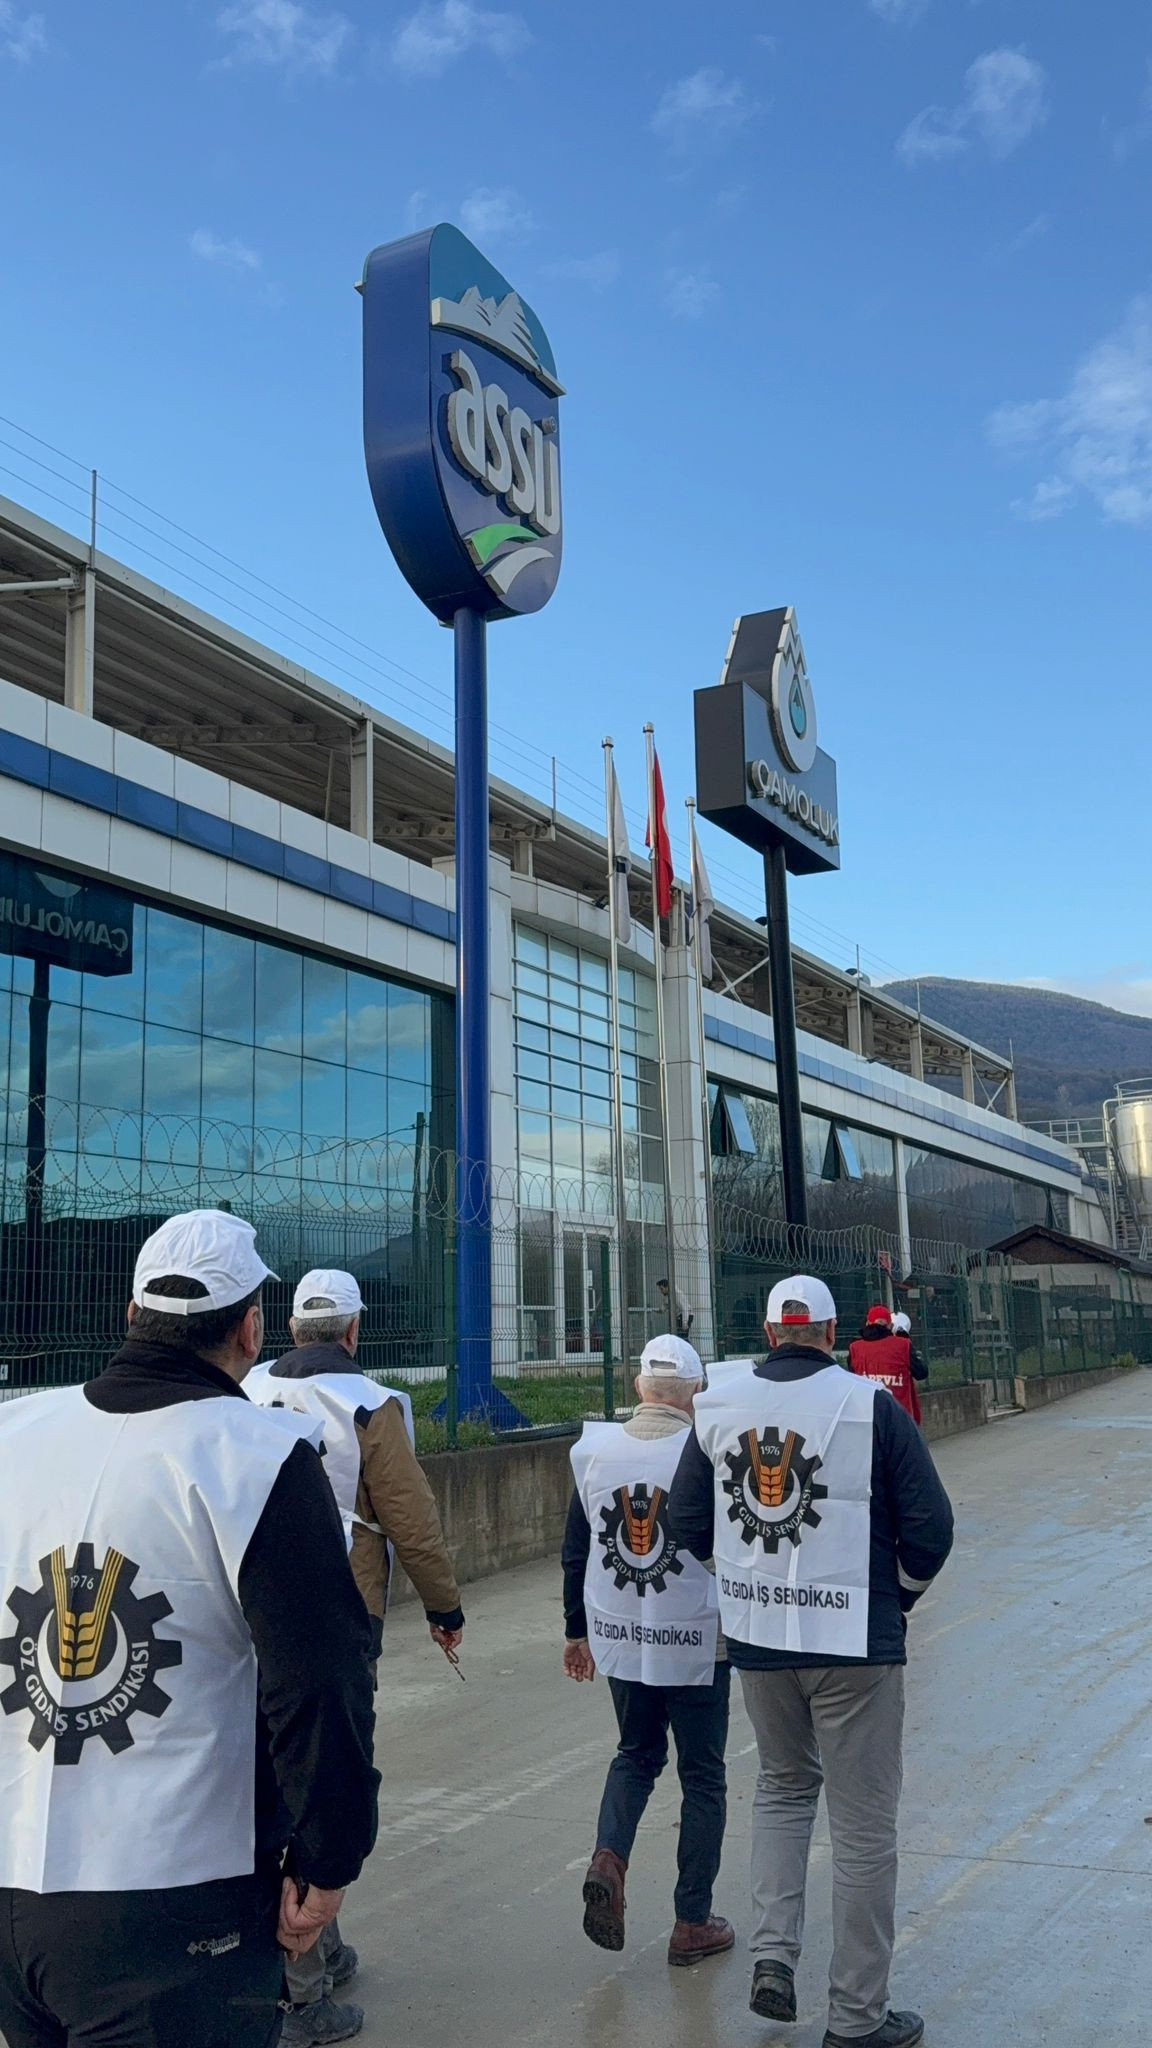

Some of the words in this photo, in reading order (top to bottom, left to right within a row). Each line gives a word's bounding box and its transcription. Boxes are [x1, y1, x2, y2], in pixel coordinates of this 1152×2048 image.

[752, 758, 839, 846] ÇAMOLUK
[760, 1445, 780, 1456] 1976
[631, 1499, 648, 1511] 1976
[733, 1486, 743, 1504] ÖZ
[738, 1506, 760, 1534] GIDA
[761, 1522, 772, 1538] İŞ
[773, 1489, 812, 1536] SENDİKASI
[607, 1537, 615, 1553] ÖZ
[612, 1555, 633, 1580] GIDA
[634, 1567, 644, 1583] İŞ
[643, 1540, 677, 1581] SENDİKASI
[70, 1575, 95, 1591] 1976
[721, 1575, 731, 1595] ÖZ
[732, 1580, 755, 1601] GIDA
[757, 1581, 770, 1608] İŞ
[773, 1585, 849, 1610] SENDİKASI
[594, 1616, 603, 1637] ÖZ
[604, 1620, 629, 1641] GIDA
[631, 1621, 642, 1646] İŞ
[642, 1623, 703, 1647] SENDİKASI
[19, 1636, 38, 1671] ÖZ
[25, 1674, 54, 1725] GIDA
[75, 1640, 150, 1732] SENDİKASI
